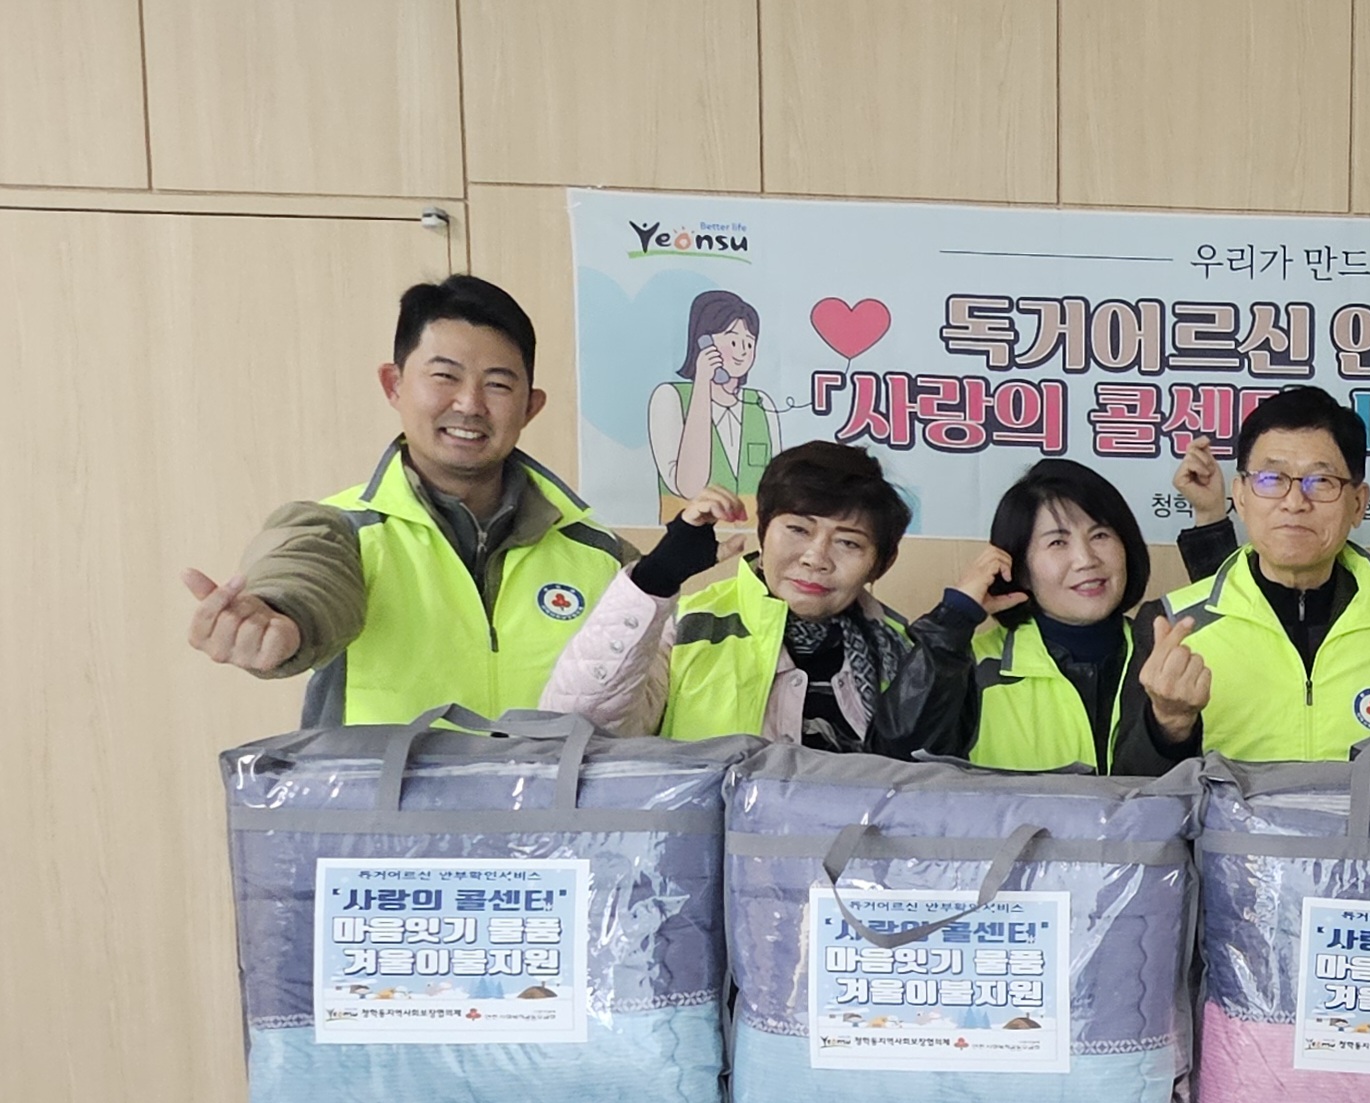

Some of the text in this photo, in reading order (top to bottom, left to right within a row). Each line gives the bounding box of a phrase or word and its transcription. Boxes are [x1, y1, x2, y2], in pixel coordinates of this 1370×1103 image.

[629, 220, 748, 253] Yeonsu
[700, 222, 747, 232] Better life
[1190, 243, 1293, 280] 우리가
[941, 293, 1314, 379] 독거어르신
[1089, 383, 1280, 460] 콜센
[332, 917, 562, 944] 마음잇기 물품
[343, 949, 560, 975] 겨울이불지원
[825, 946, 1044, 975] 마음잇기 물품
[836, 977, 1043, 1007] 겨울이불지원
